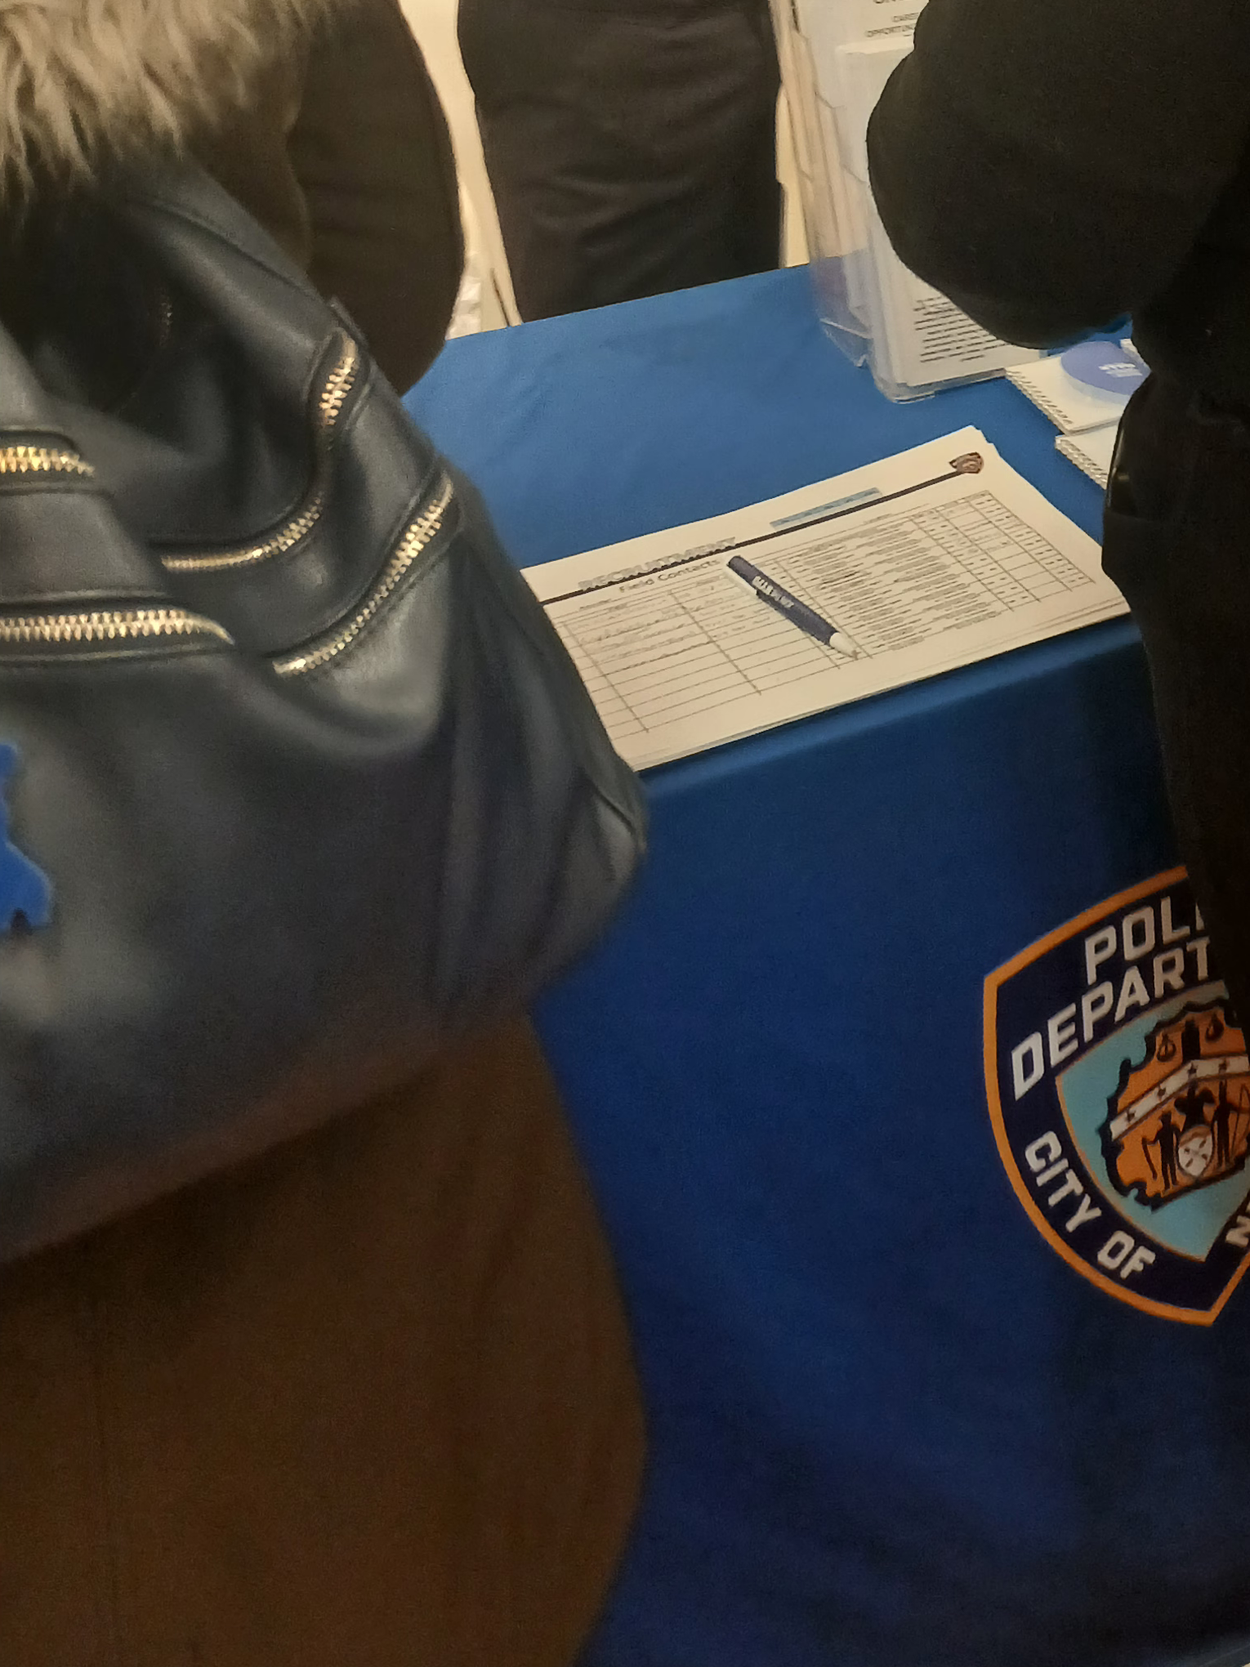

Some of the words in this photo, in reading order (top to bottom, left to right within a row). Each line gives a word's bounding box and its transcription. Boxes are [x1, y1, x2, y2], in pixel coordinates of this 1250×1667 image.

[657, 558, 721, 581] Contacts
[1011, 936, 1211, 1102] DEPART
[1025, 1130, 1102, 1233] CITY
[1097, 1230, 1156, 1280] OF
